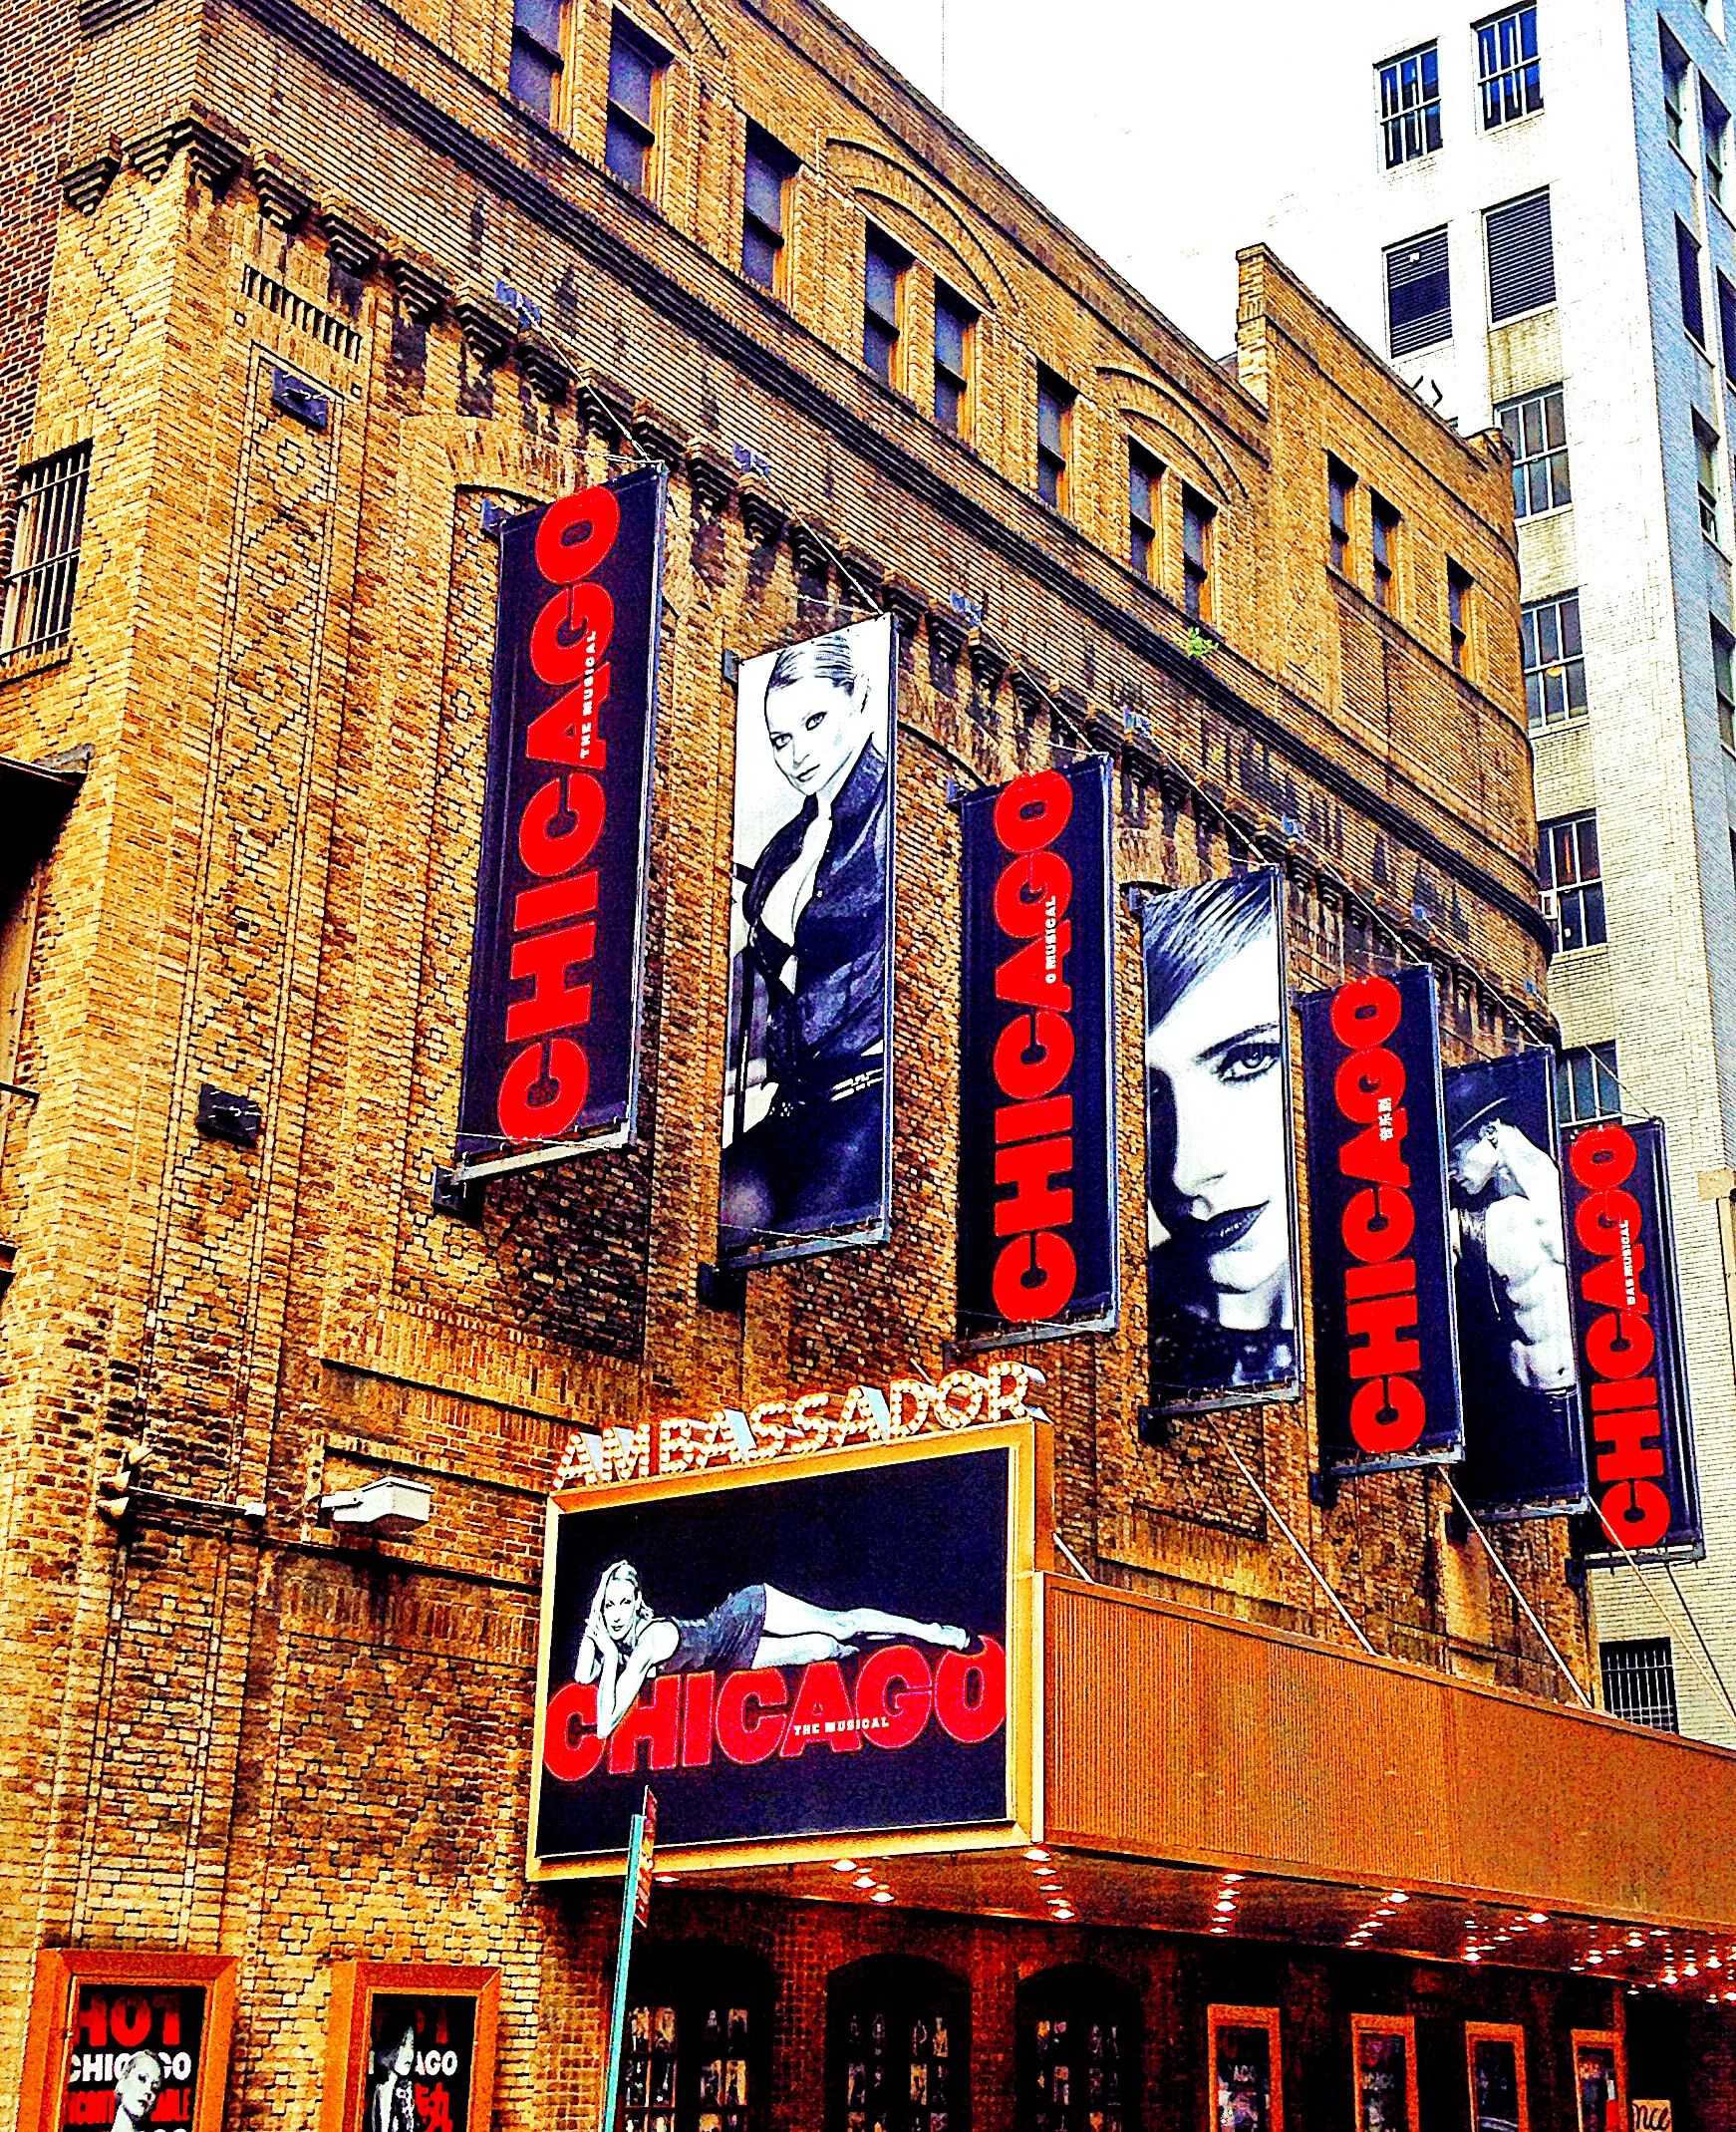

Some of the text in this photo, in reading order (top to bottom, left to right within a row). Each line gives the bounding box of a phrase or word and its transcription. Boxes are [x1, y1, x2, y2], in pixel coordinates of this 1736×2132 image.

[579, 630, 597, 761] THE MUSICAL
[498, 484, 621, 1145] CHICAGO
[1043, 895, 1057, 985] O MUSICAL
[993, 768, 1076, 1324] CHICAGO
[1330, 976, 1426, 1455] CHICAGO
[1618, 1219, 1633, 1277] MUSICAL
[1570, 1123, 1671, 1548] CHICAGO
[550, 1360, 1038, 1491] AMBASSADOR
[541, 1634, 1008, 1782] CHICAGO
[793, 1715, 890, 1736] THE MUSICAL
[69, 2051, 192, 2083] CHICGO
